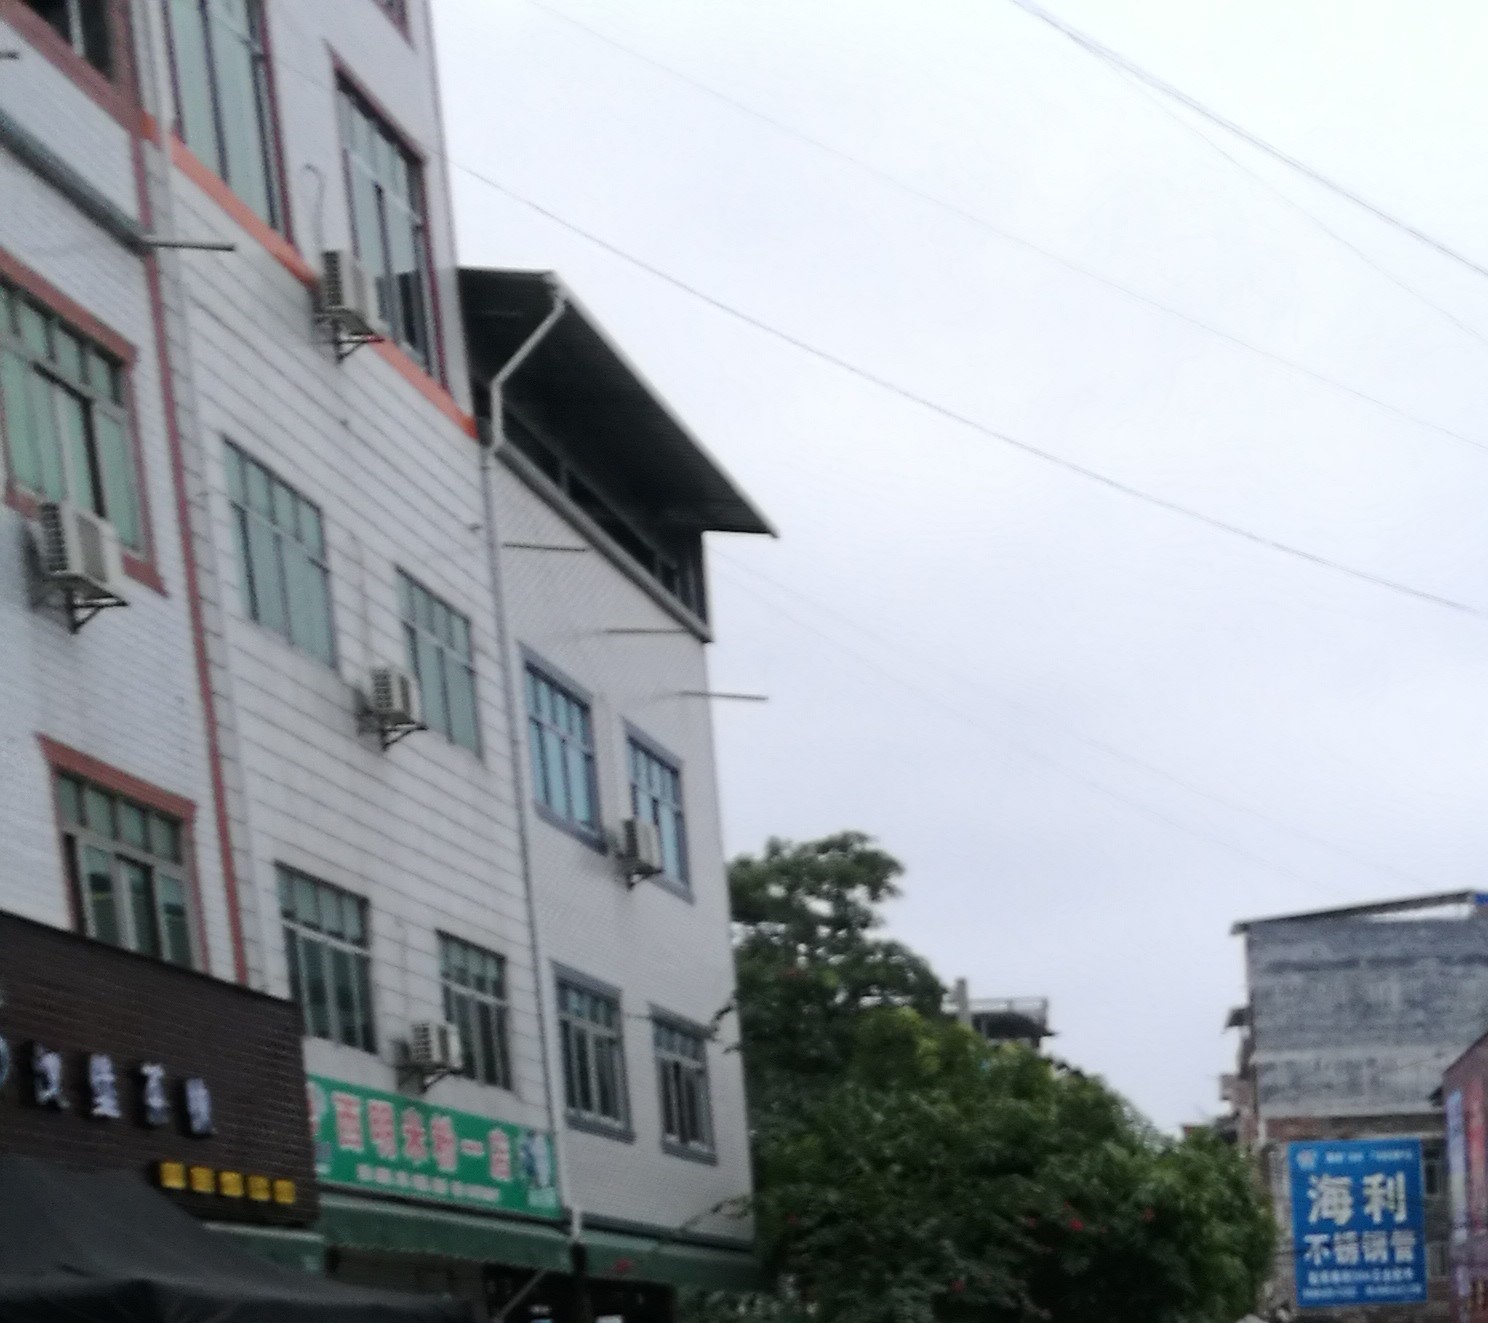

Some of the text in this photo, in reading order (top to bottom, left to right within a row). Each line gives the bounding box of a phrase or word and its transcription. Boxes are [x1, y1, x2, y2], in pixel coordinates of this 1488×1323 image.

[1306, 1171, 1407, 1226] 海利
[1303, 1229, 1416, 1265] 不锈钢管
